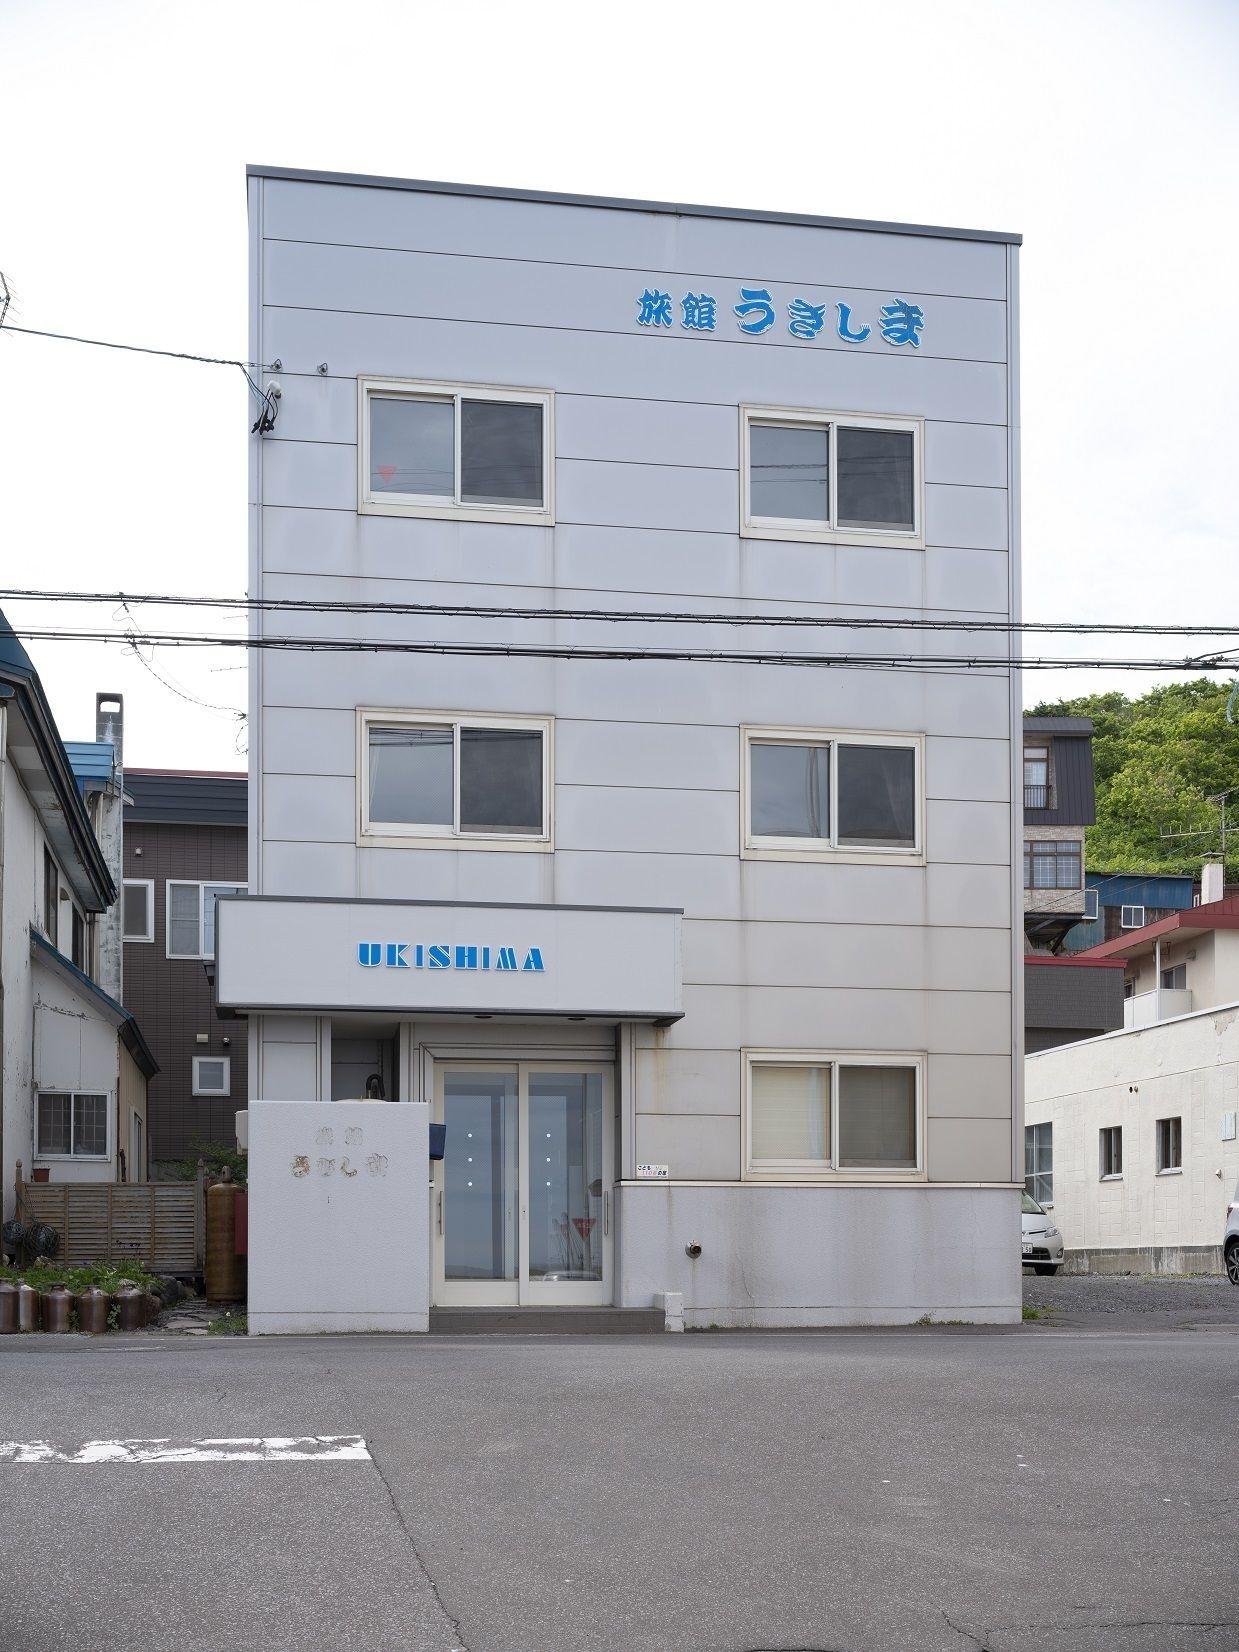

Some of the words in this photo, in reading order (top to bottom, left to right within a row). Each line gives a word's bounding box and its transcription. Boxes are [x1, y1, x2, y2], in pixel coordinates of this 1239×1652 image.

[636, 287, 717, 331] 旅館
[734, 287, 925, 348] うきしま
[358, 943, 546, 971] UKISHIMA
